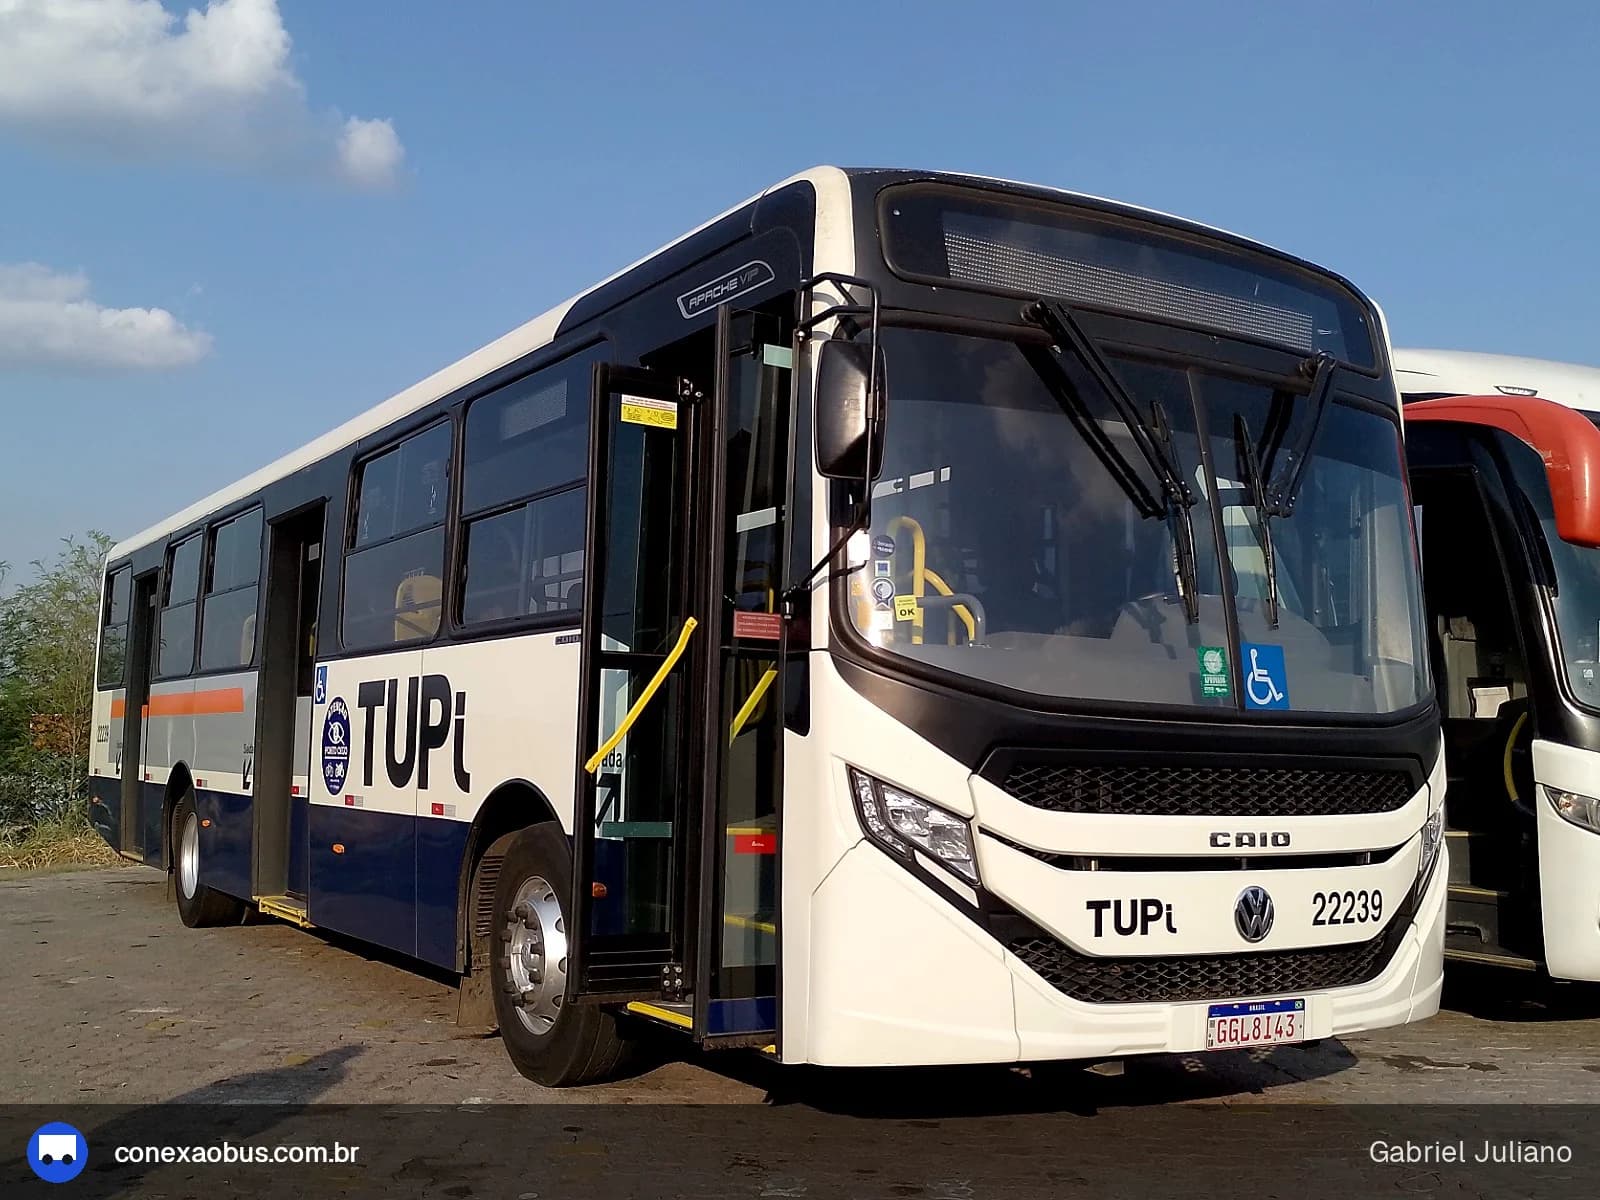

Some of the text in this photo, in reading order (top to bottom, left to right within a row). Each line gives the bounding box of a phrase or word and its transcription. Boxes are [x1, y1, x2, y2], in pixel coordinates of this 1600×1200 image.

[688, 267, 759, 310] APACHE VIP
[899, 608, 915, 617] OK
[1209, 831, 1290, 847] CAIO
[1312, 889, 1382, 926] 22239
[1217, 1014, 1295, 1043] GGL8I43
